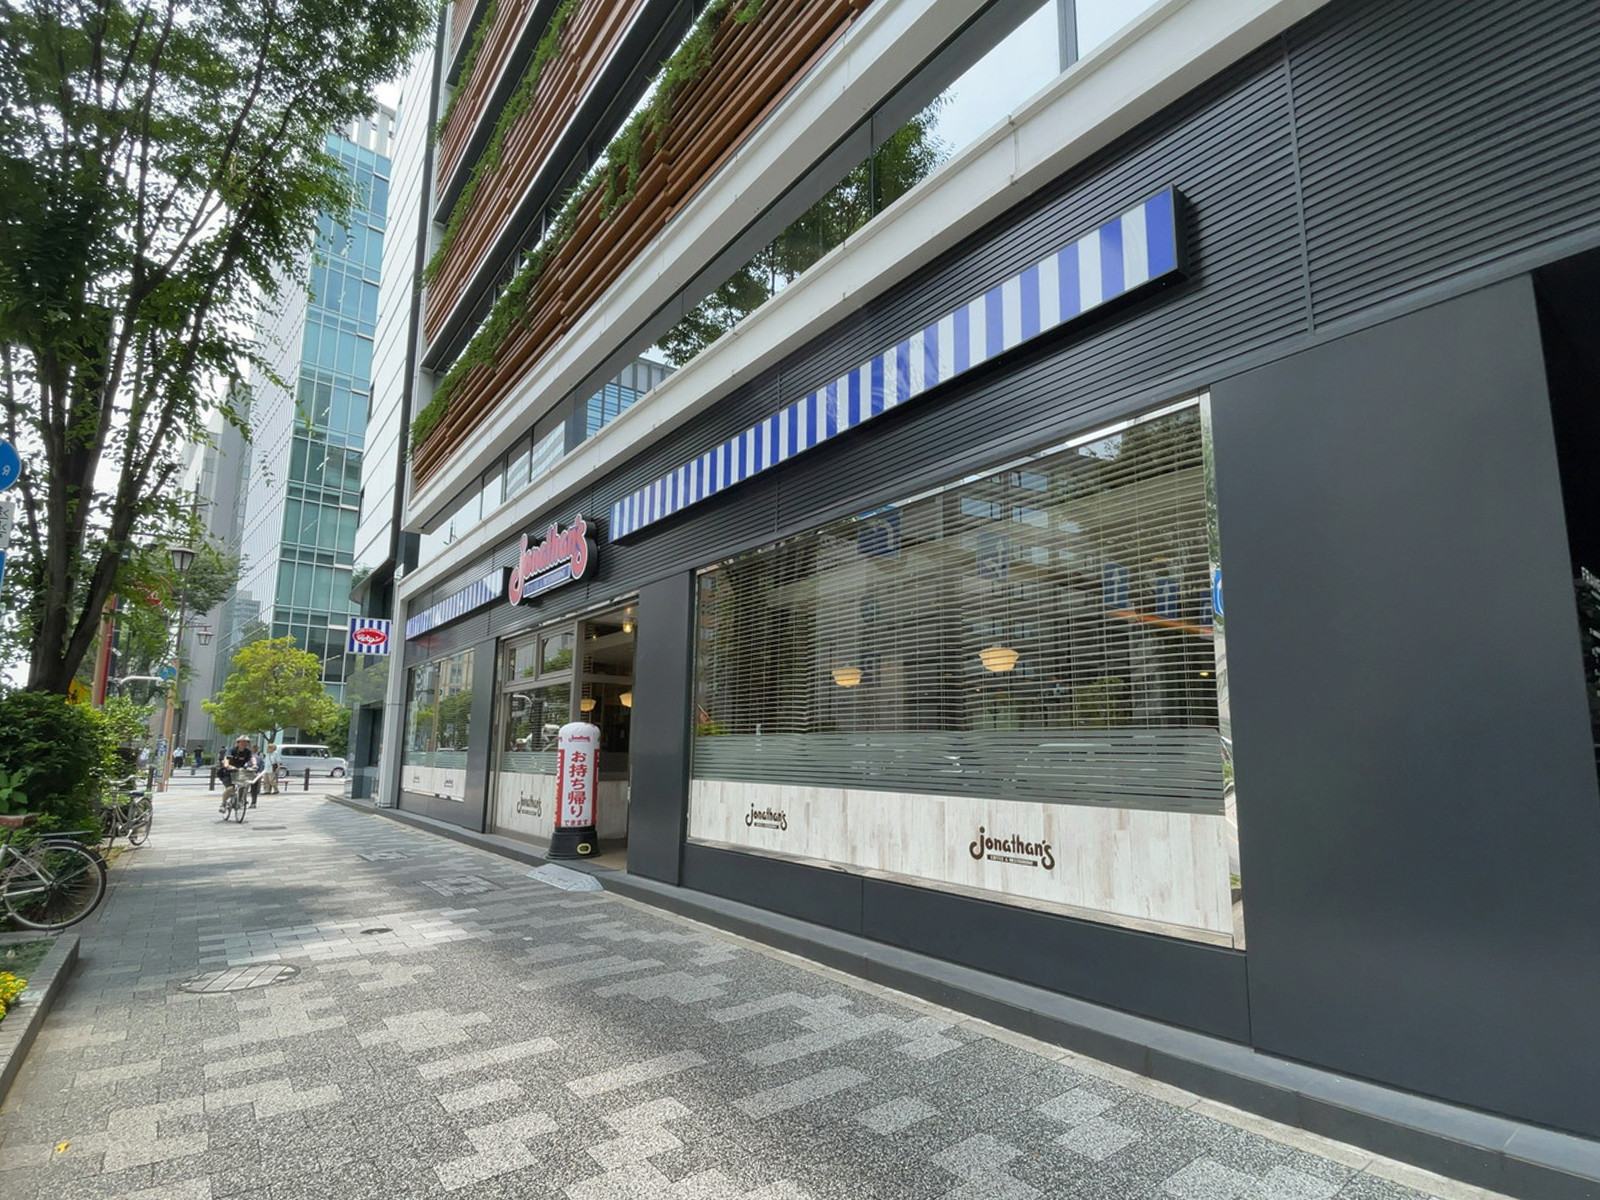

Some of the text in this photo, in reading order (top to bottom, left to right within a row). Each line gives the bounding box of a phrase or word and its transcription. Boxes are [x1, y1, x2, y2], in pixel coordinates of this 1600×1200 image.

[568, 751, 588, 818] お持ち帰り
